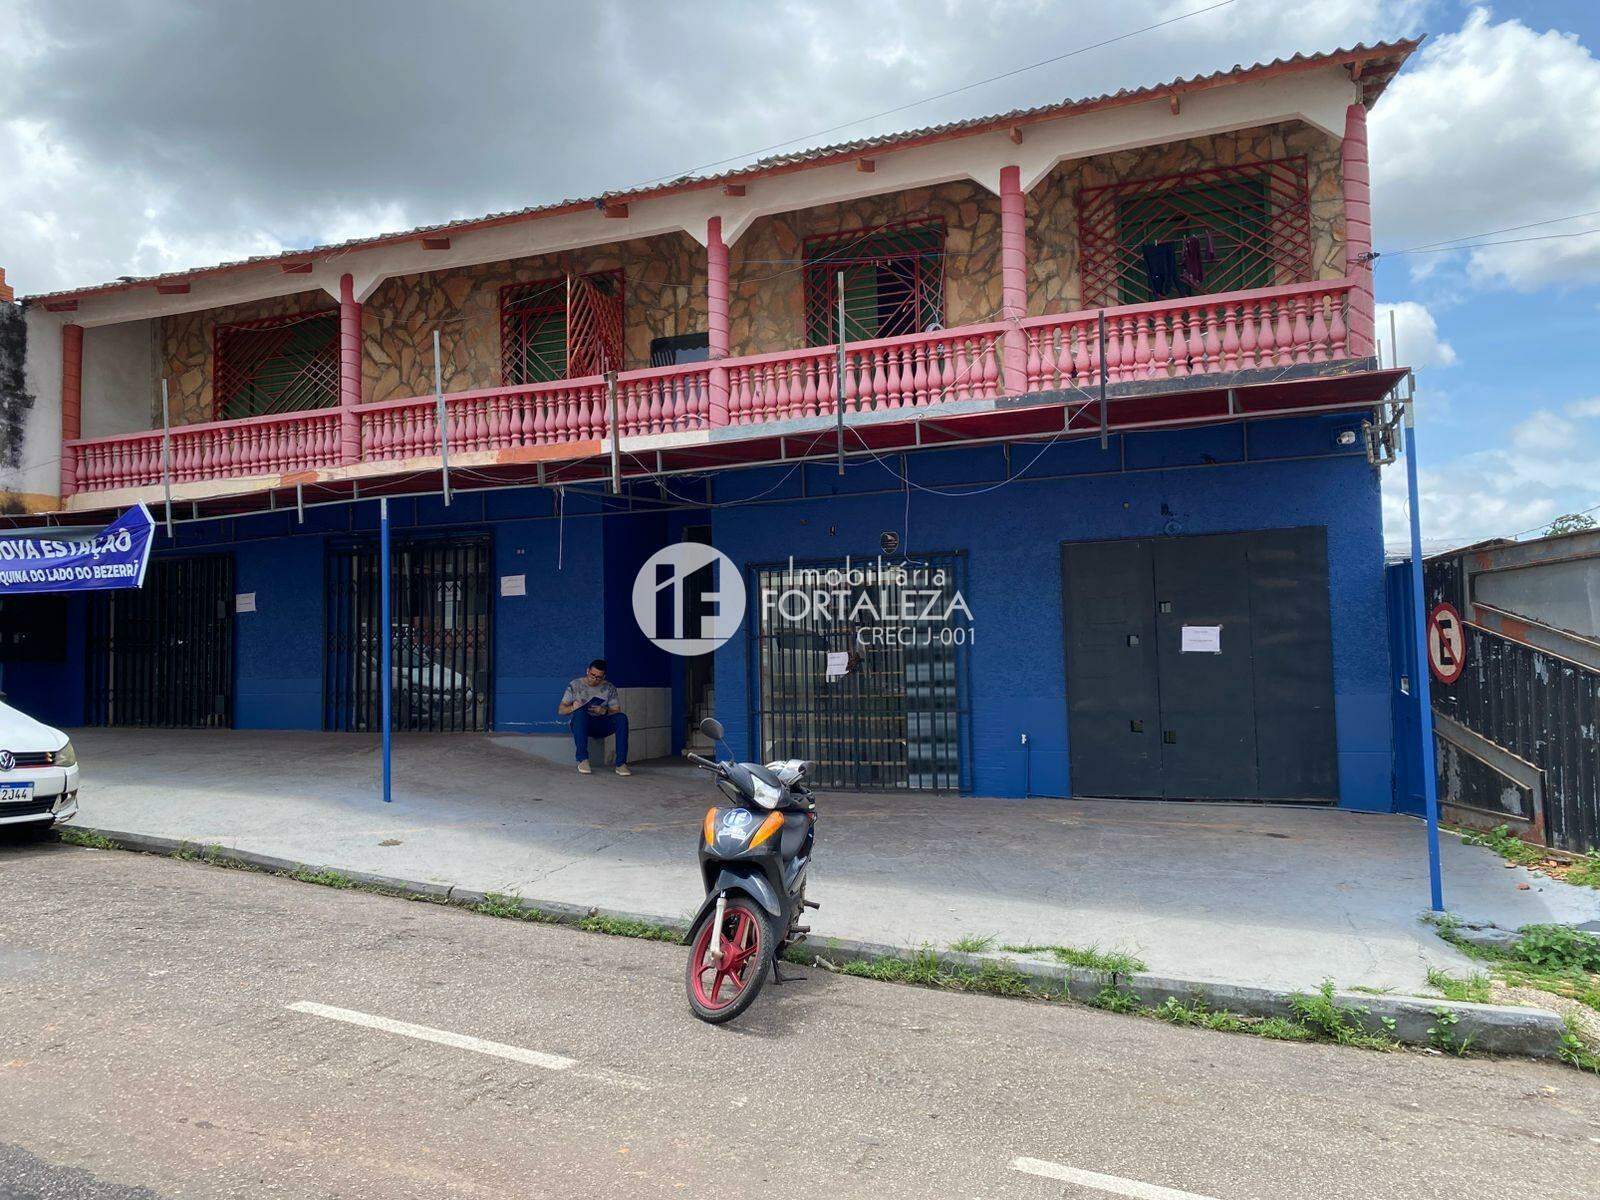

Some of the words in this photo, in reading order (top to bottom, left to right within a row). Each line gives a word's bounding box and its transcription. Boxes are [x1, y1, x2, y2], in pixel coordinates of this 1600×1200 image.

[0, 539, 40, 560] OVA
[0, 569, 31, 586] QUINA
[30, 568, 46, 582] DO
[46, 566, 74, 582] LADO
[75, 566, 92, 580] DO
